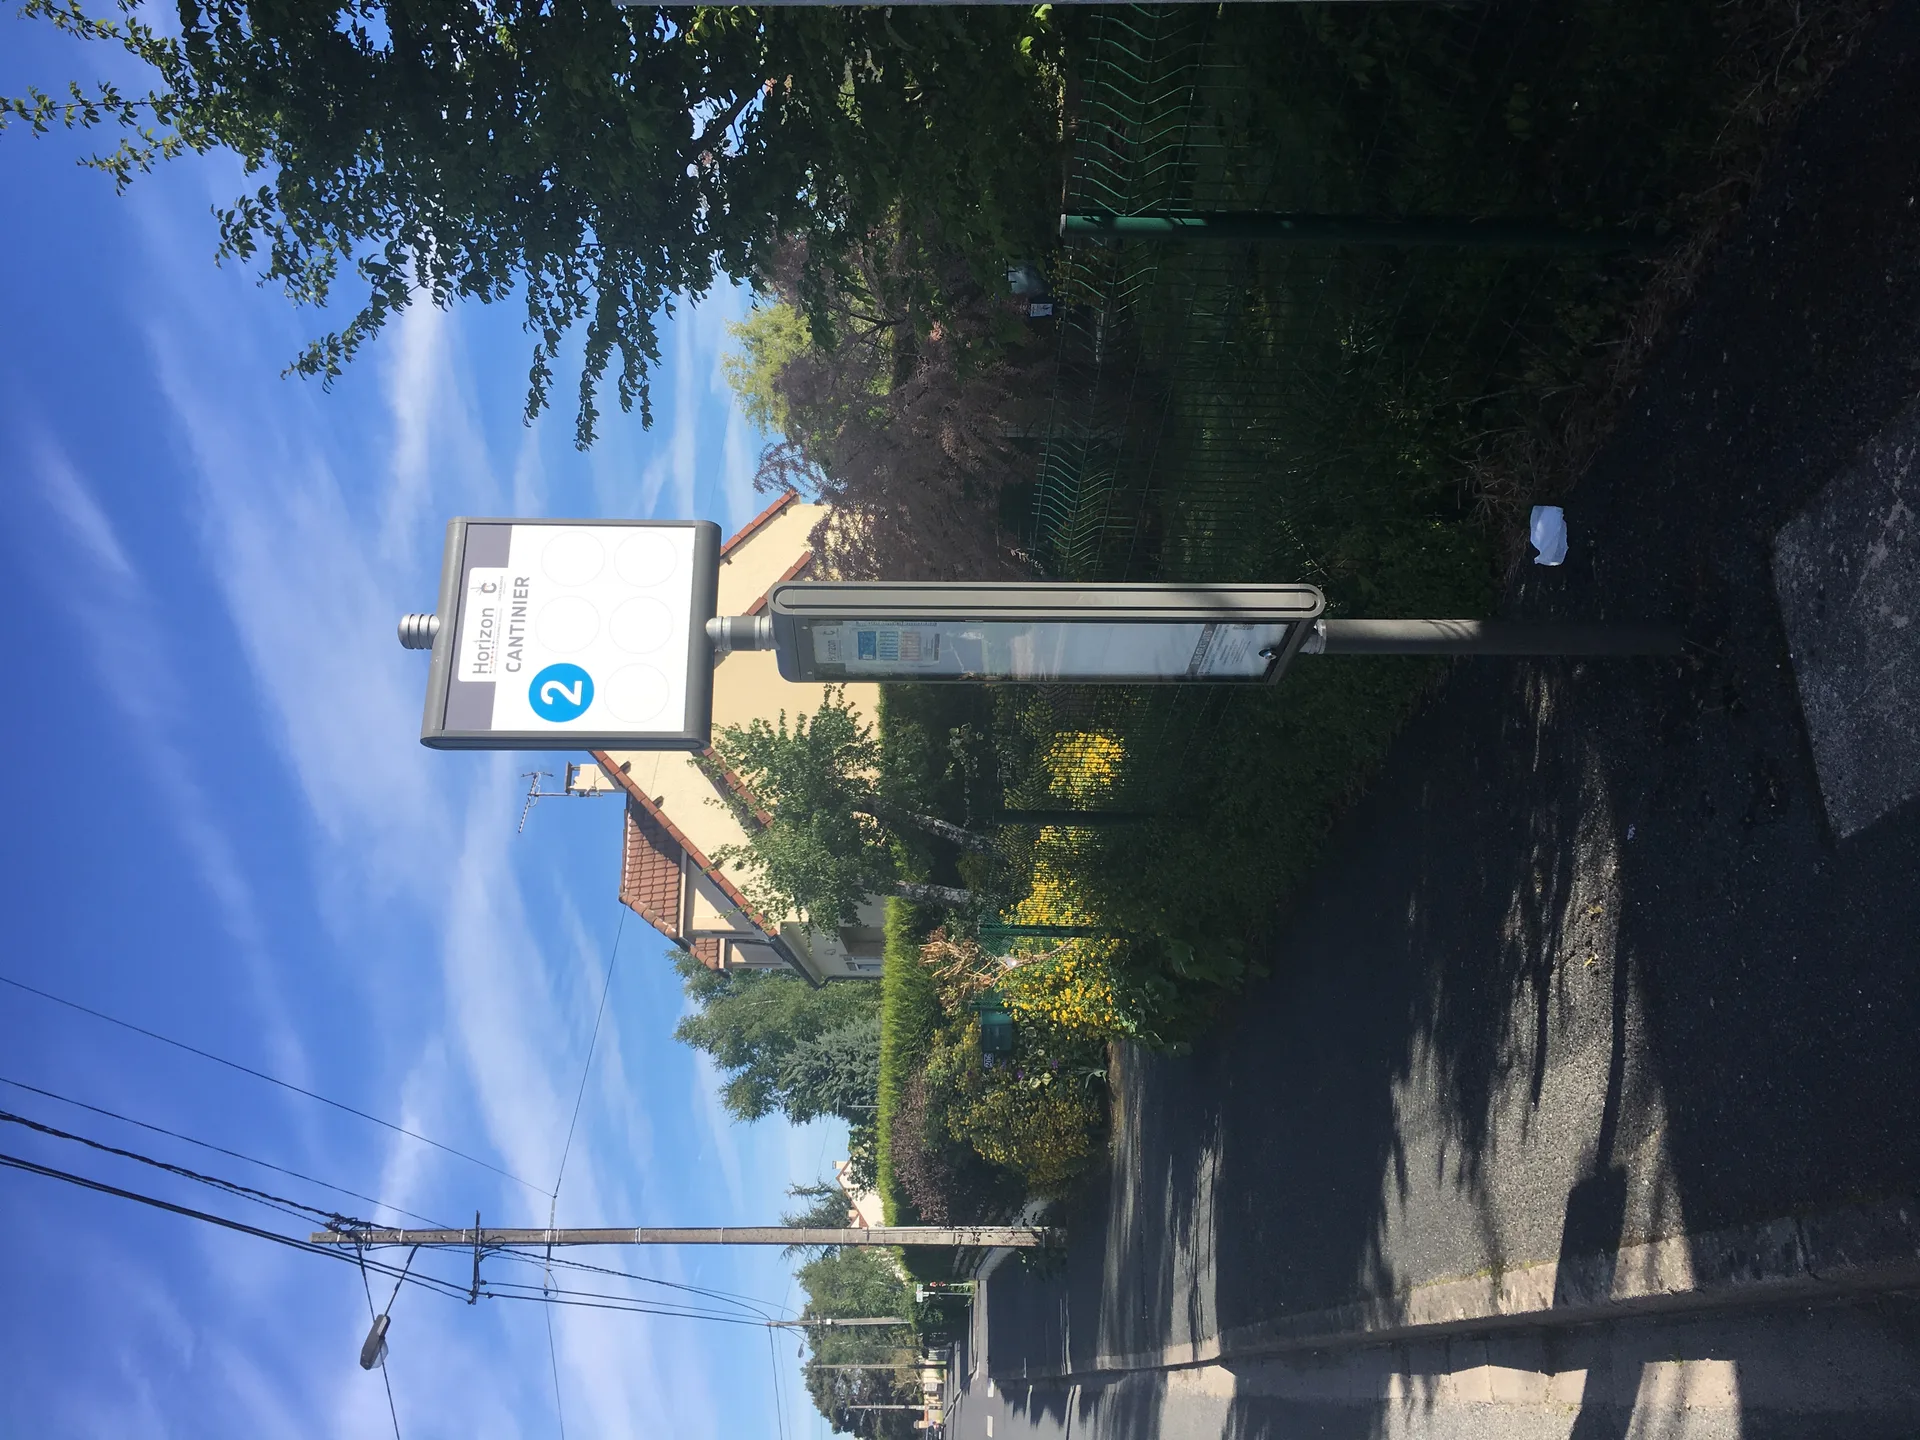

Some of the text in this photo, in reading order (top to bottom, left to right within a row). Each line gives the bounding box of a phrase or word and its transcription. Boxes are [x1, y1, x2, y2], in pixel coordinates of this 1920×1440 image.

[472, 608, 495, 674] Horizon
[506, 576, 530, 673] CANTINIER
[540, 680, 583, 706] 2
